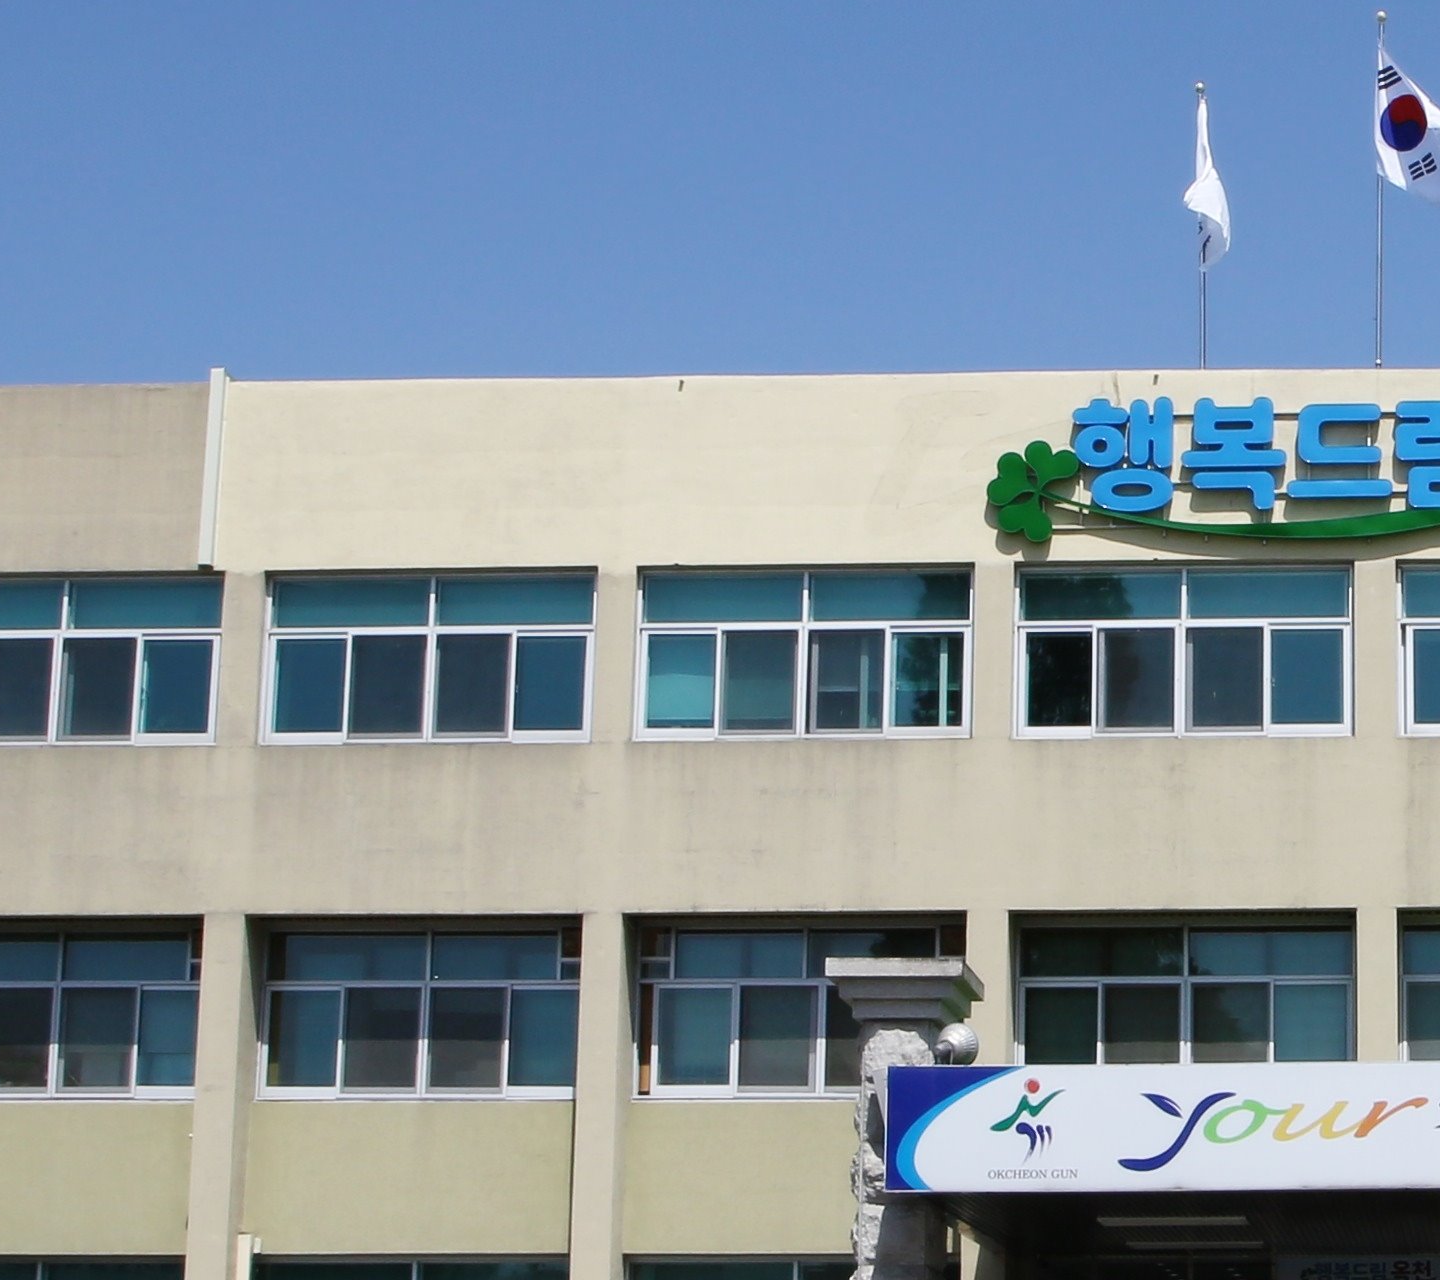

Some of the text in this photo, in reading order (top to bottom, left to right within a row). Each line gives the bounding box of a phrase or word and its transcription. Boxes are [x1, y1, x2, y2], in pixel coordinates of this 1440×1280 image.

[1117, 1091, 1429, 1172] your
[987, 1169, 1079, 1180] OKCHEON GUN
